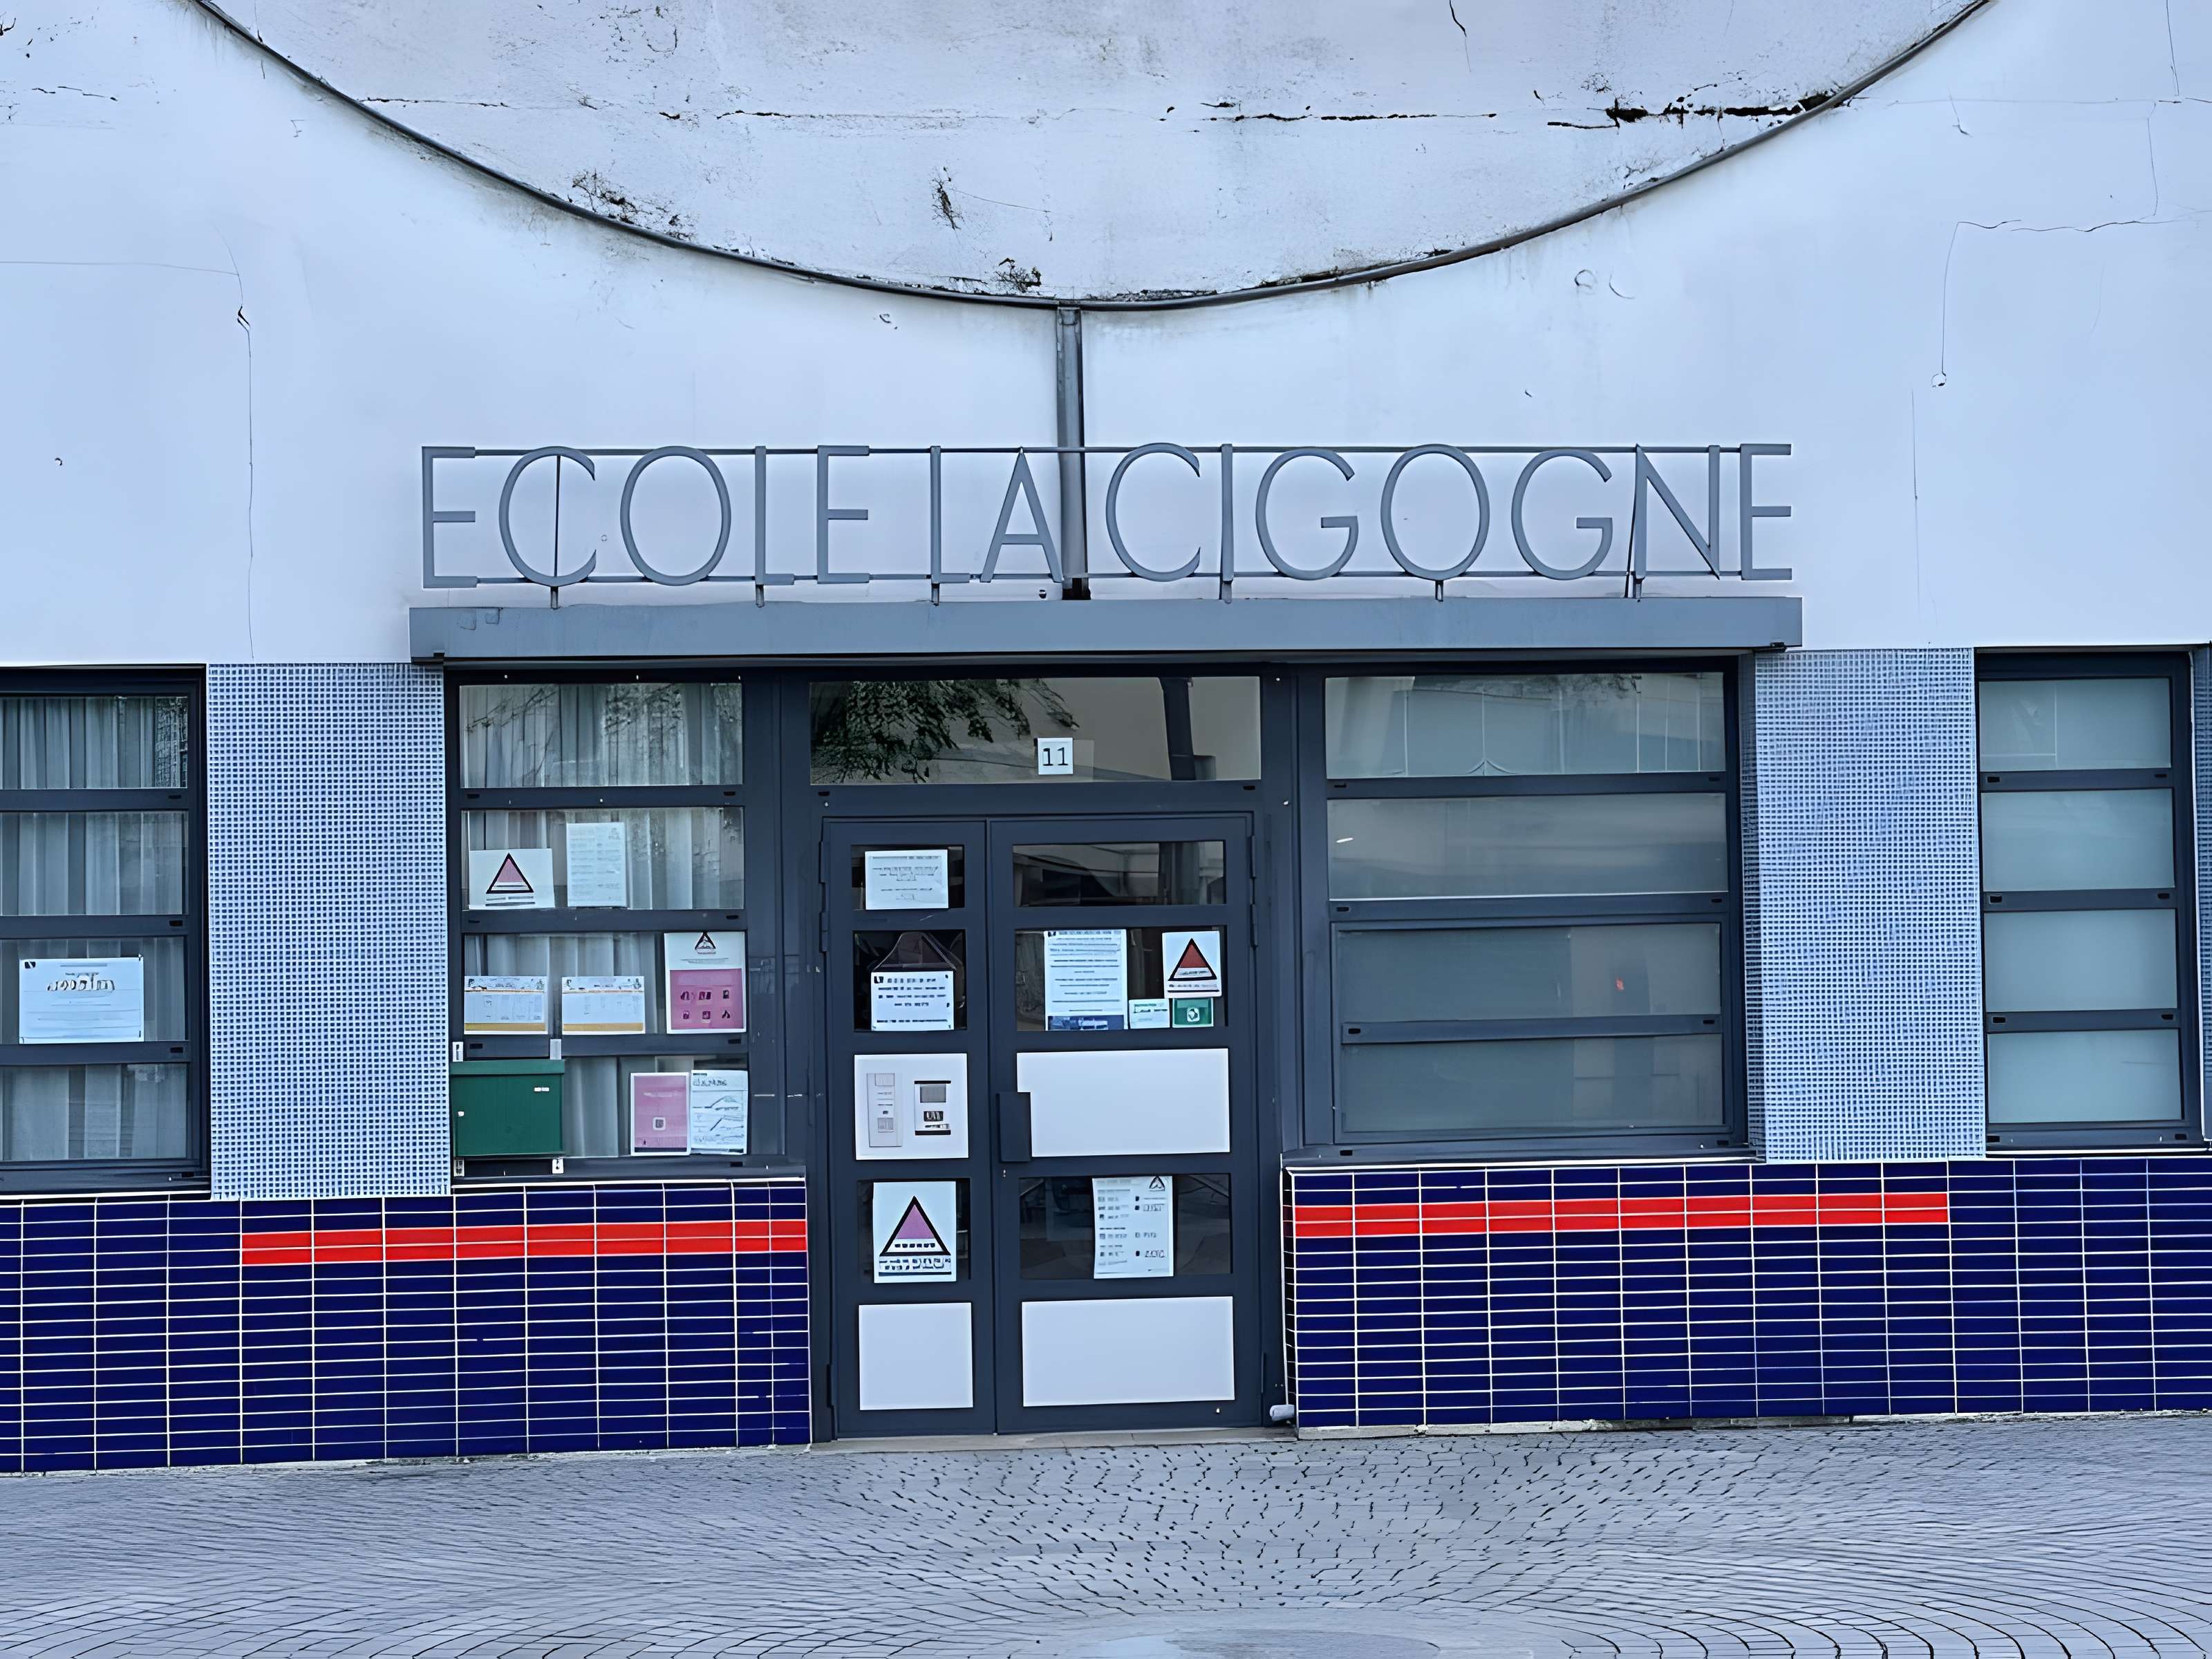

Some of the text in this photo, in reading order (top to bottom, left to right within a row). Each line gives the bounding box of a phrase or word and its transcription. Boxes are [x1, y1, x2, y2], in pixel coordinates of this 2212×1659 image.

[422, 442, 1792, 588] ECOLE LA CIGOGNE
[1042, 747, 1069, 766] 11
